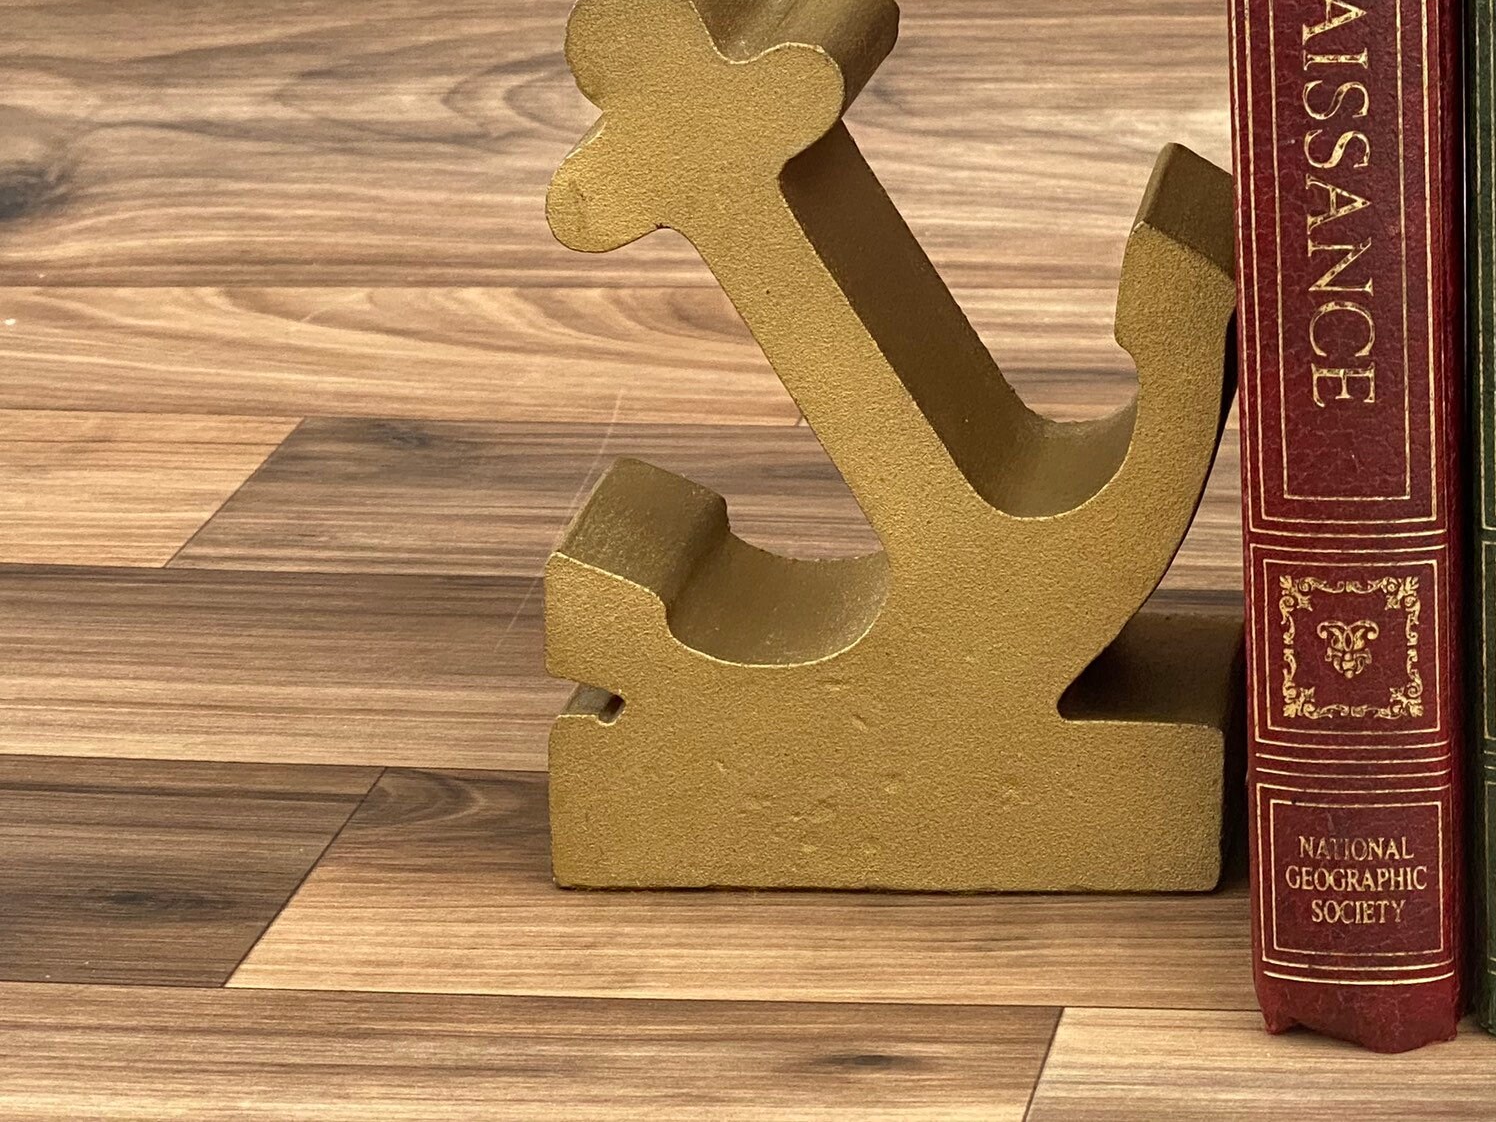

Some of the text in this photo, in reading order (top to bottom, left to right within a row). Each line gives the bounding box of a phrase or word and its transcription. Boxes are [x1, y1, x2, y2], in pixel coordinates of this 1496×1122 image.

[1298, 835, 1414, 861] NATIONAL
[1285, 863, 1428, 892] GEOGRAPHIC
[1310, 898, 1406, 924] SOCIETY
